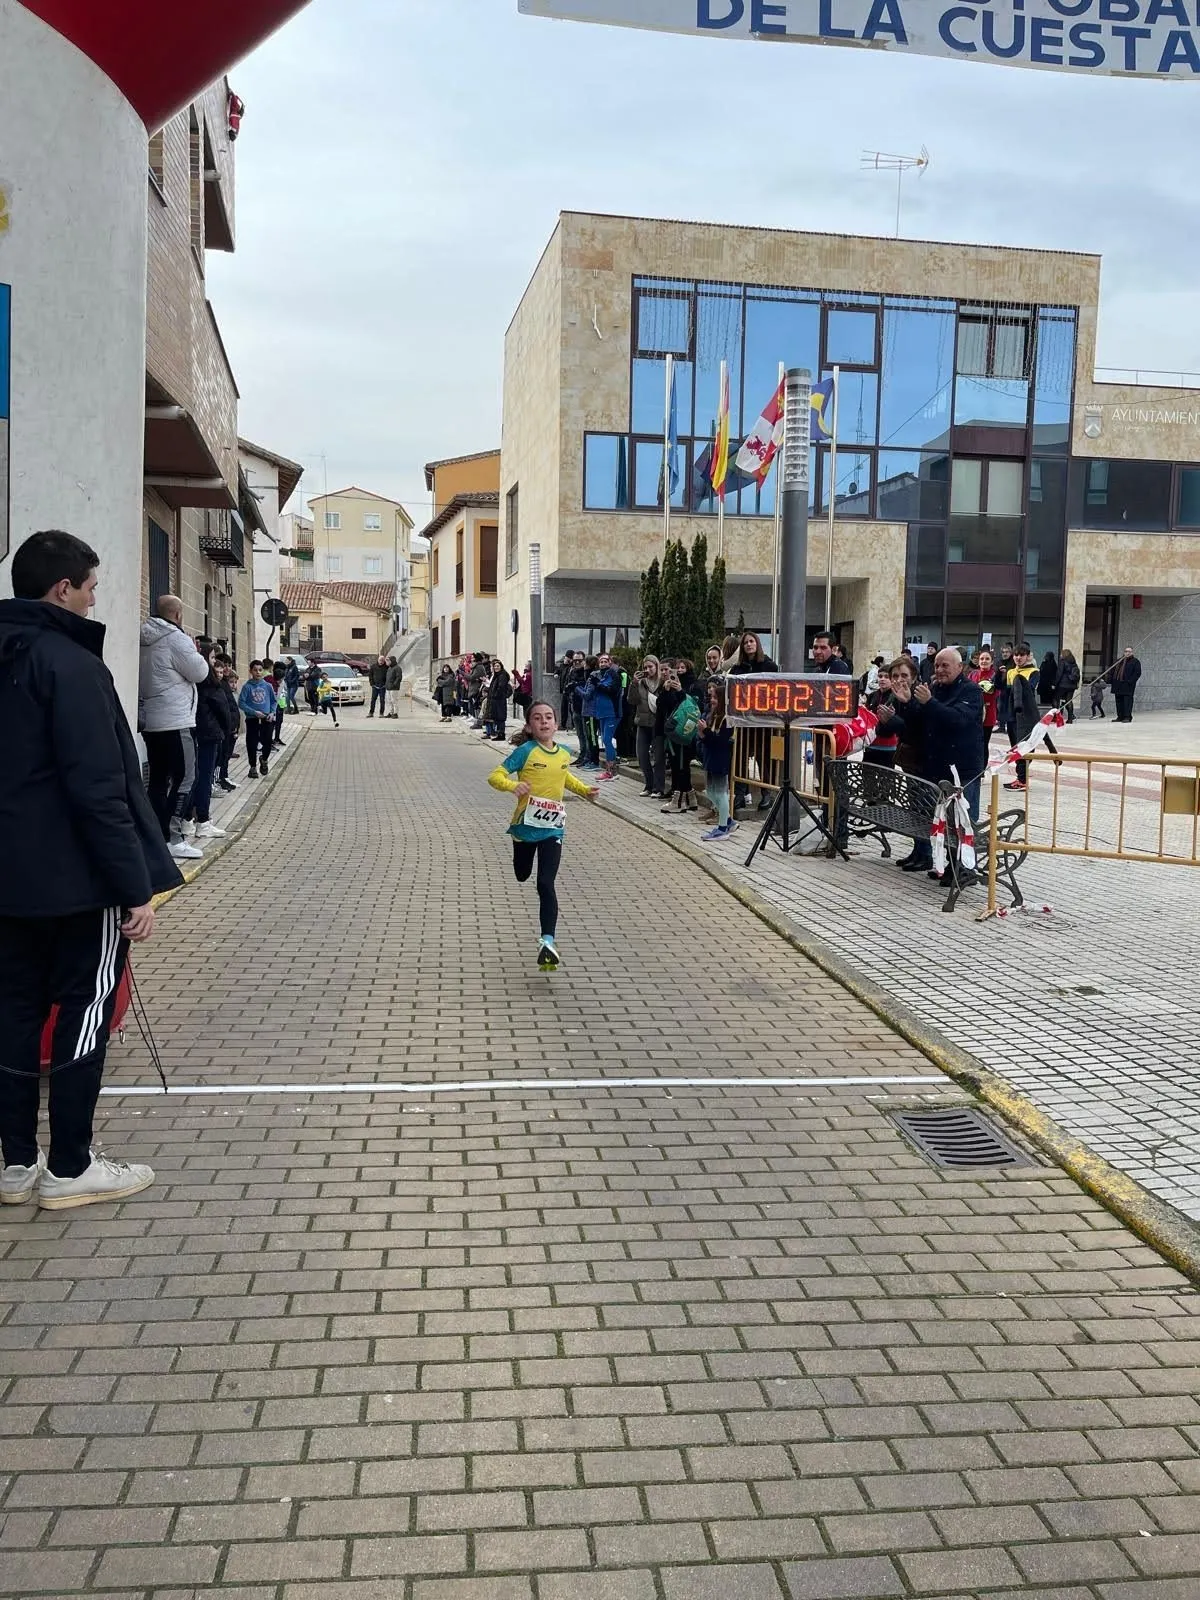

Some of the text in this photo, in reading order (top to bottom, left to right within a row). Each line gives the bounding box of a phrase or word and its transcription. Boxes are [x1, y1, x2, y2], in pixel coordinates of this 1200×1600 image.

[697, 0, 787, 34] DE
[819, 0, 908, 45] LA
[938, 6, 1200, 73] CUESTA
[1112, 408, 1200, 425] AYUNTAMIEN
[534, 809, 559, 822] 447
